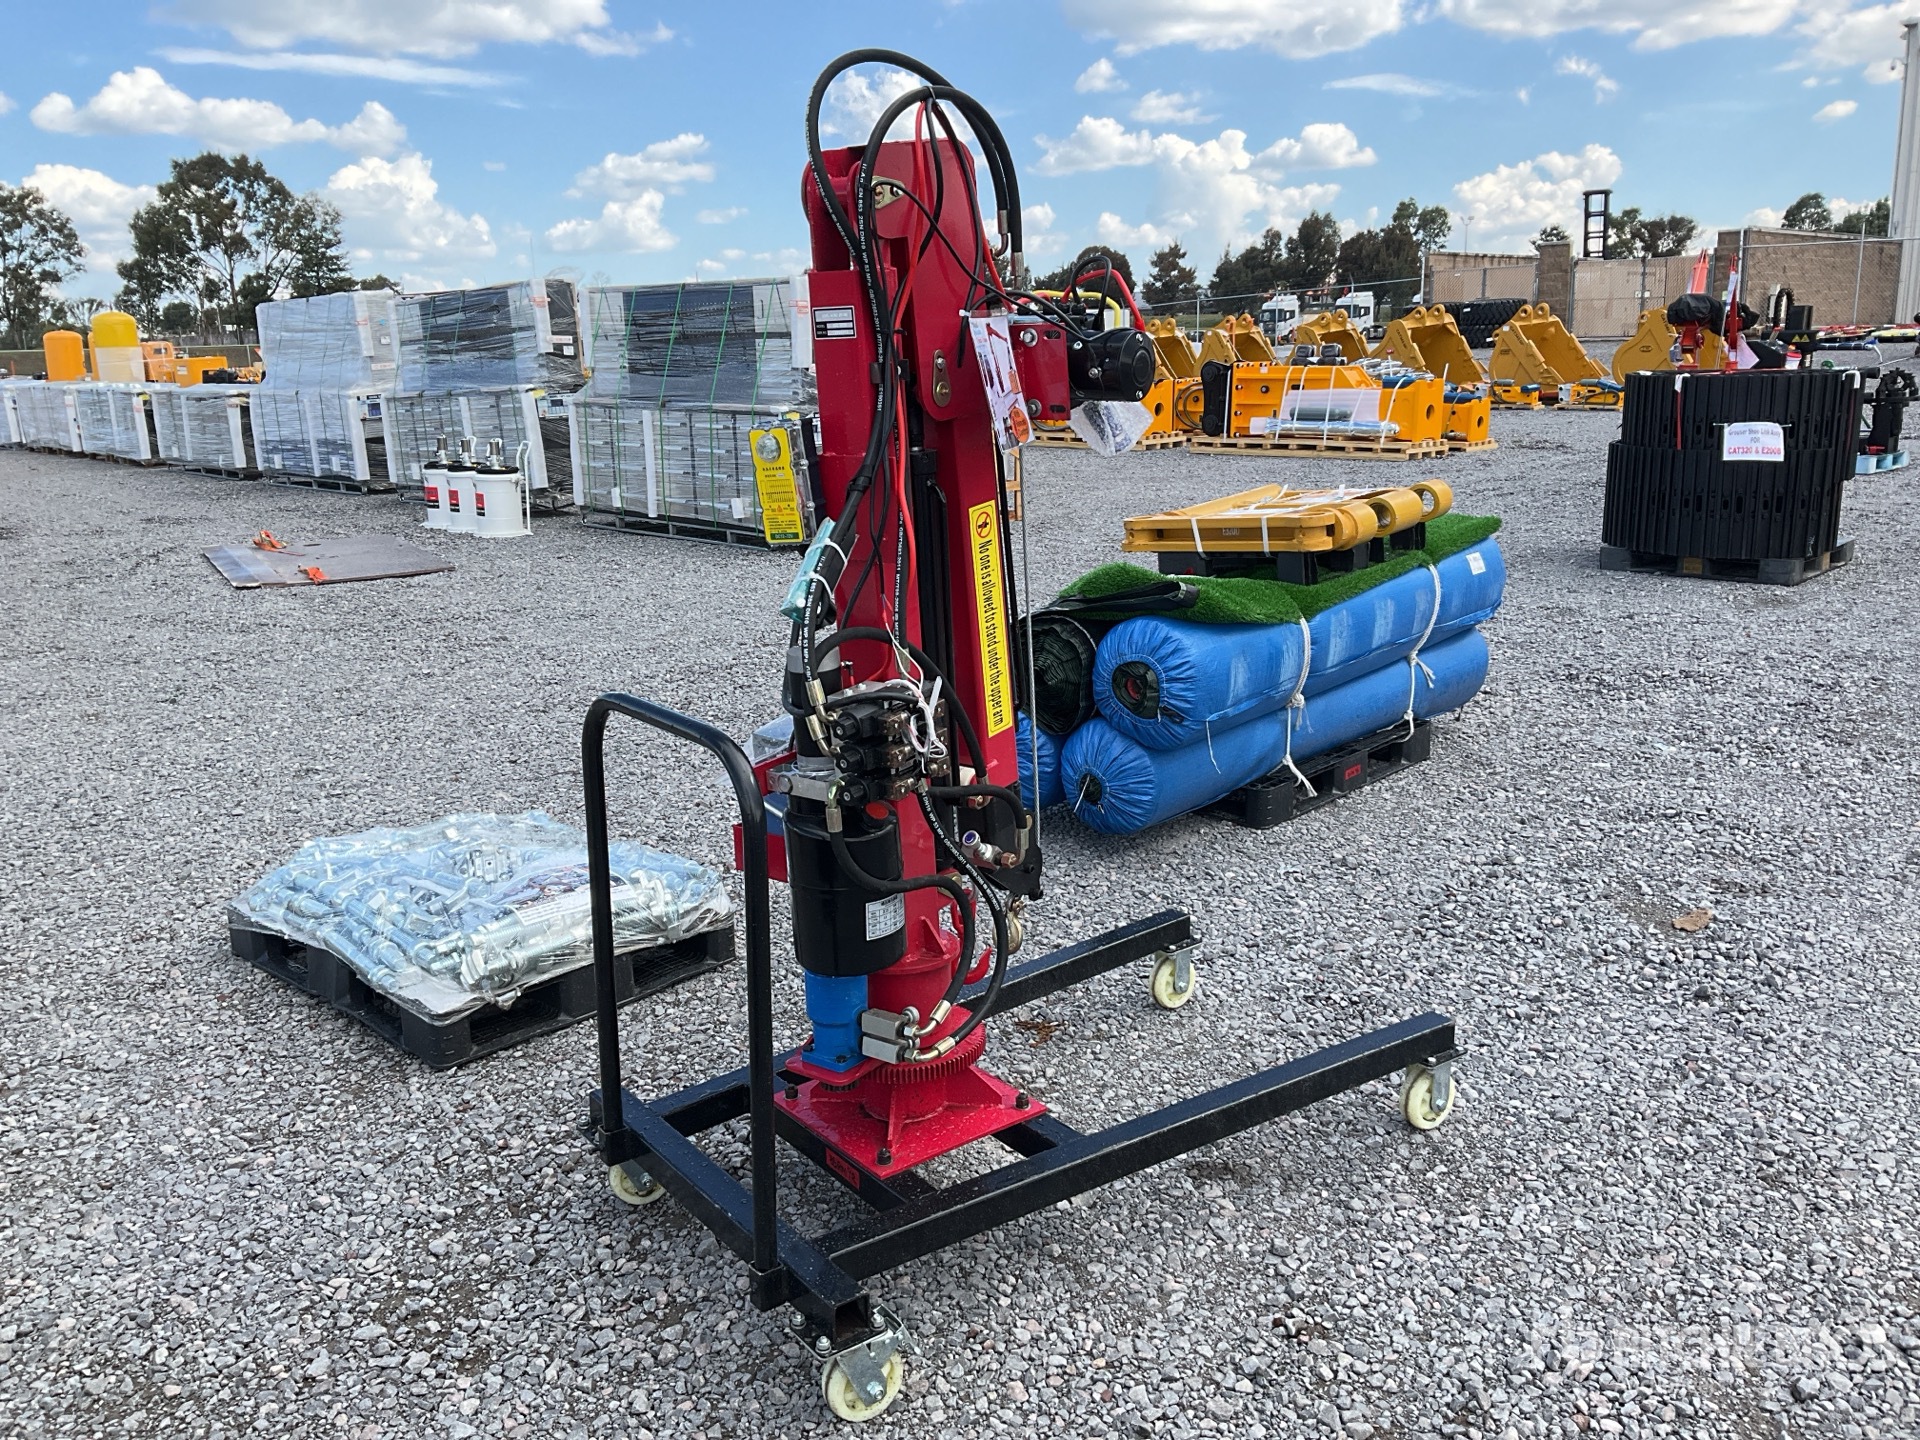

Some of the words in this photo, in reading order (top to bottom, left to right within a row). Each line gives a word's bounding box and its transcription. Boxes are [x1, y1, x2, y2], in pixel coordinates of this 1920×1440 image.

[862, 252, 869, 264] WP
[1728, 447, 1752, 455] CAT320
[979, 539, 993, 554] No
[979, 554, 991, 571] one
[981, 569, 995, 580] is
[981, 580, 998, 614] allowed
[984, 612, 996, 624] to
[803, 626, 809, 638] WP
[986, 623, 1001, 648] stand
[987, 647, 1003, 671] under
[990, 670, 1004, 687] the
[988, 685, 1003, 710] upper
[993, 709, 1004, 728] arm
[928, 811, 936, 822] WP
